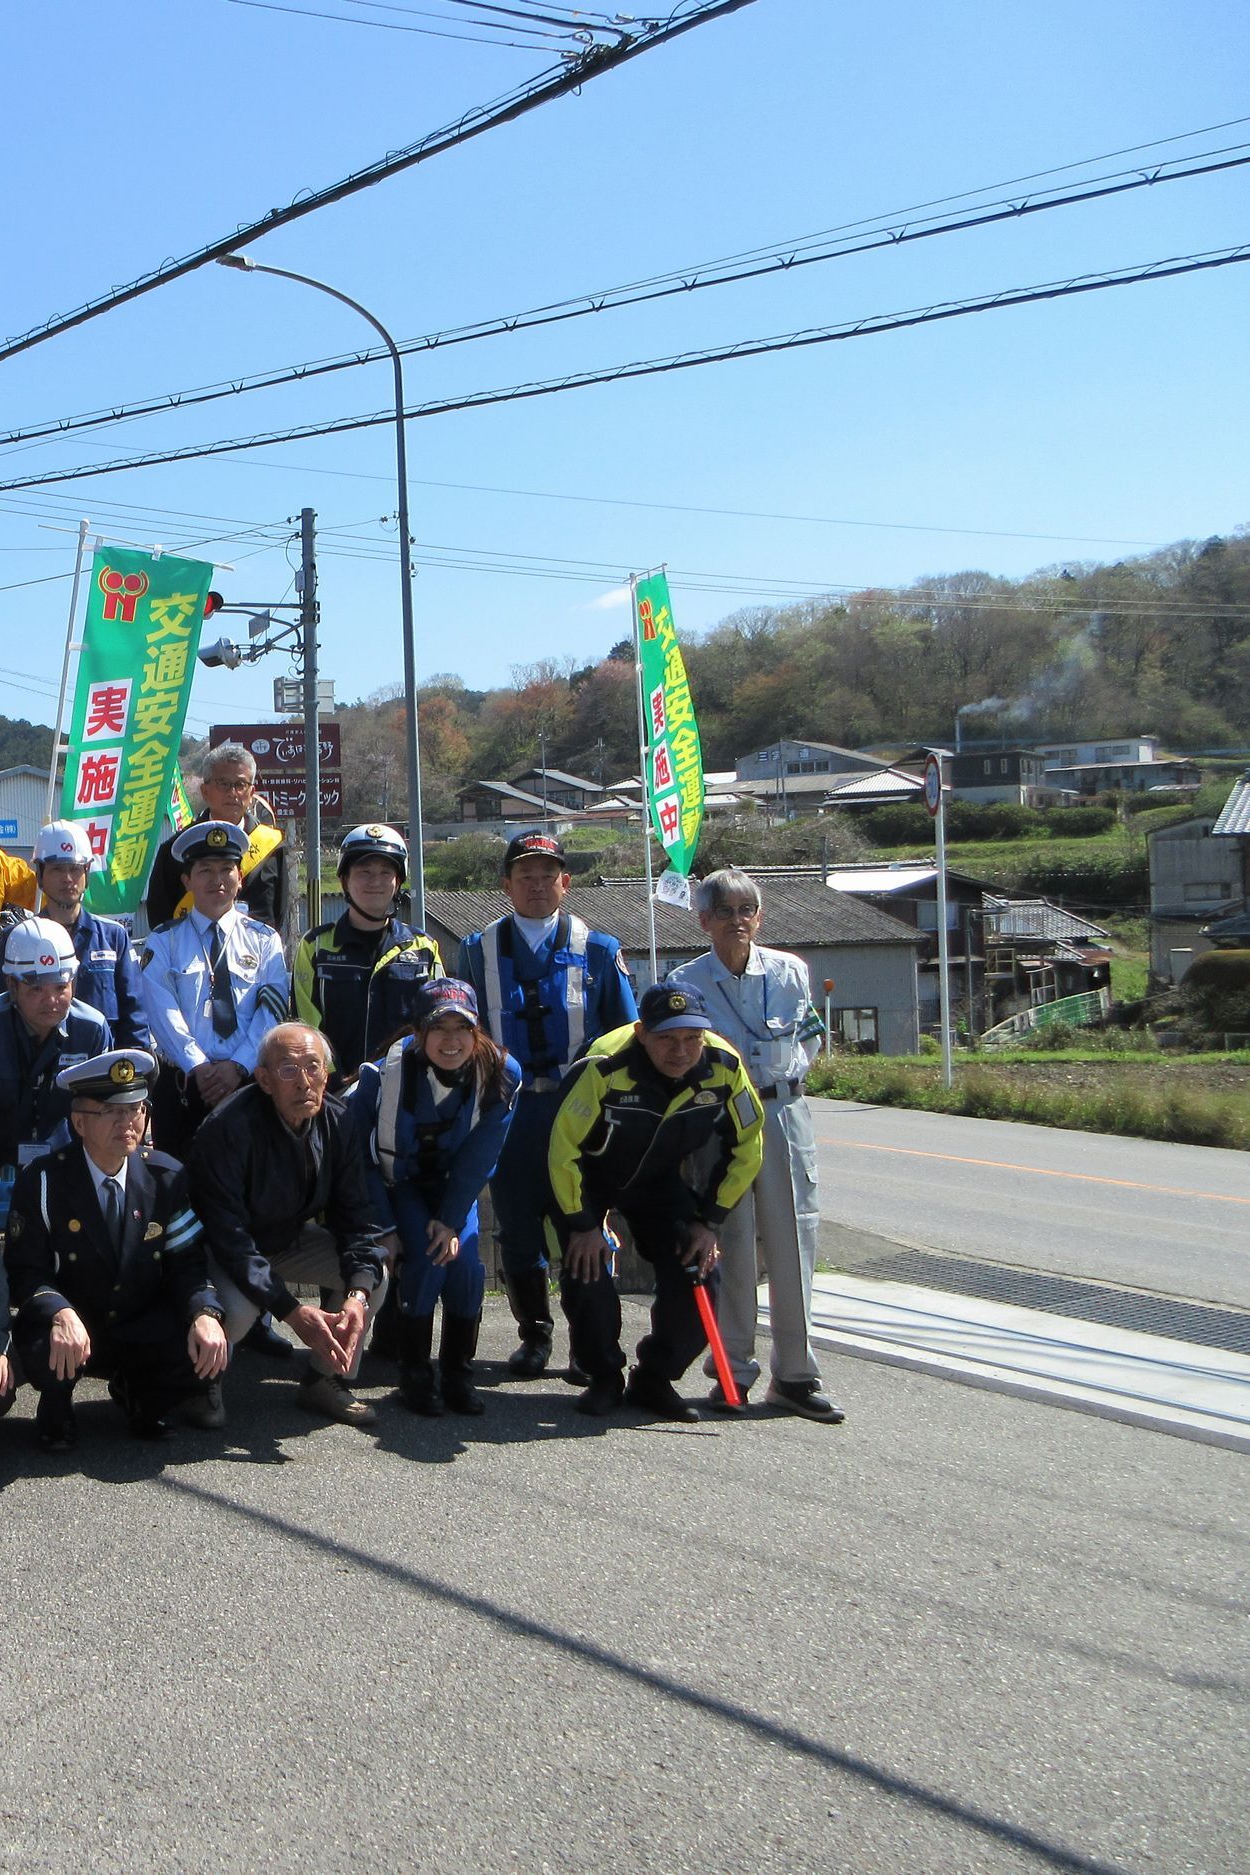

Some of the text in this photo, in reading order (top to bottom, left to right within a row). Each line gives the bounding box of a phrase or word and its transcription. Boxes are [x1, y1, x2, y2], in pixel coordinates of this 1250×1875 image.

[109, 592, 199, 884] 交通安全運動
[652, 690, 680, 841] 実施中
[655, 606, 701, 849] 交通安全運動
